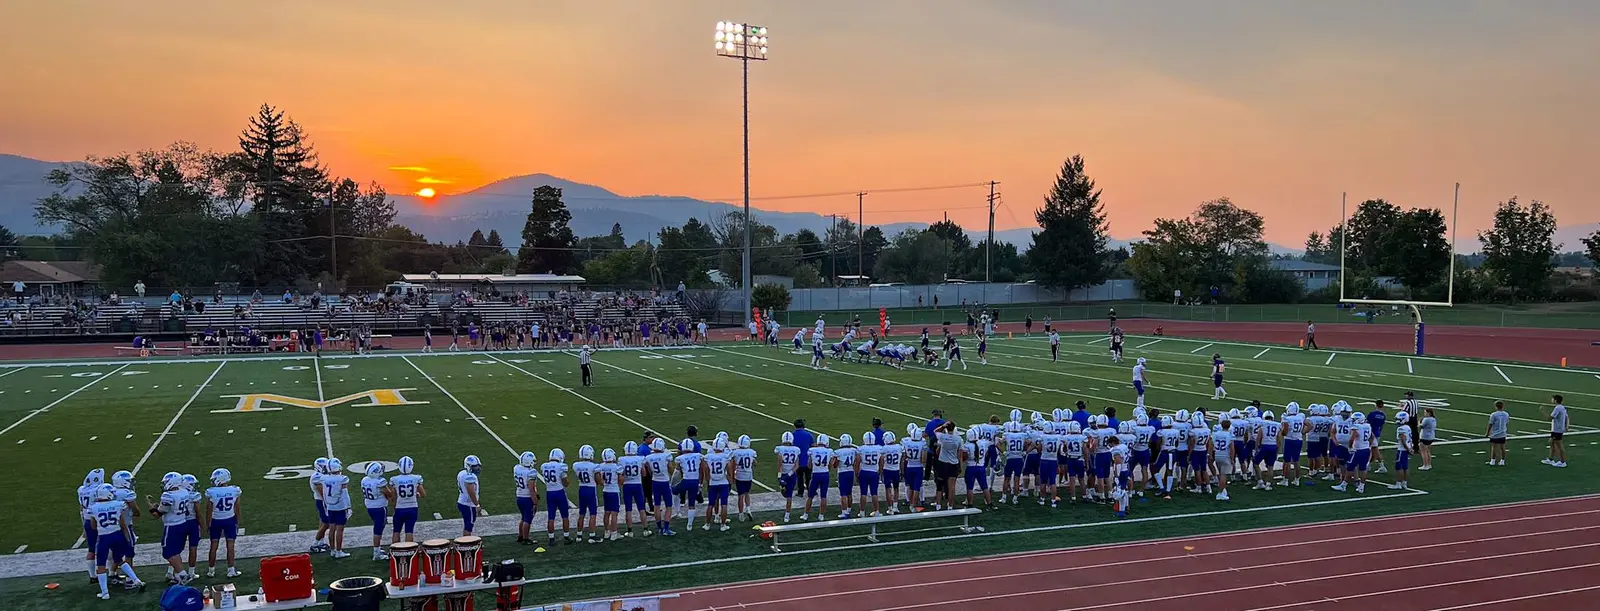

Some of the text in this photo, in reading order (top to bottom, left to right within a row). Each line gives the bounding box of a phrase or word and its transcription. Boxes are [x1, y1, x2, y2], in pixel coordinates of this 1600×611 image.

[210, 388, 430, 413] M
[1266, 426, 1278, 436] 19
[1138, 433, 1149, 444] 21
[1196, 435, 1209, 446] 27
[1010, 440, 1022, 452] 20
[1046, 442, 1057, 452] 31
[1068, 442, 1080, 452] 43
[1214, 440, 1226, 450] 32
[782, 454, 796, 464] 33
[865, 454, 878, 466] 55
[886, 454, 898, 465] 82
[907, 448, 920, 460] 37
[688, 460, 697, 472] 11
[738, 457, 751, 470] 40
[814, 455, 828, 467] 34
[624, 465, 638, 477] 83
[652, 462, 660, 474] 9
[710, 462, 723, 474] 12
[326, 484, 332, 496] 7
[398, 484, 414, 498] 63
[216, 496, 234, 512] 45
[98, 511, 118, 528] 25
